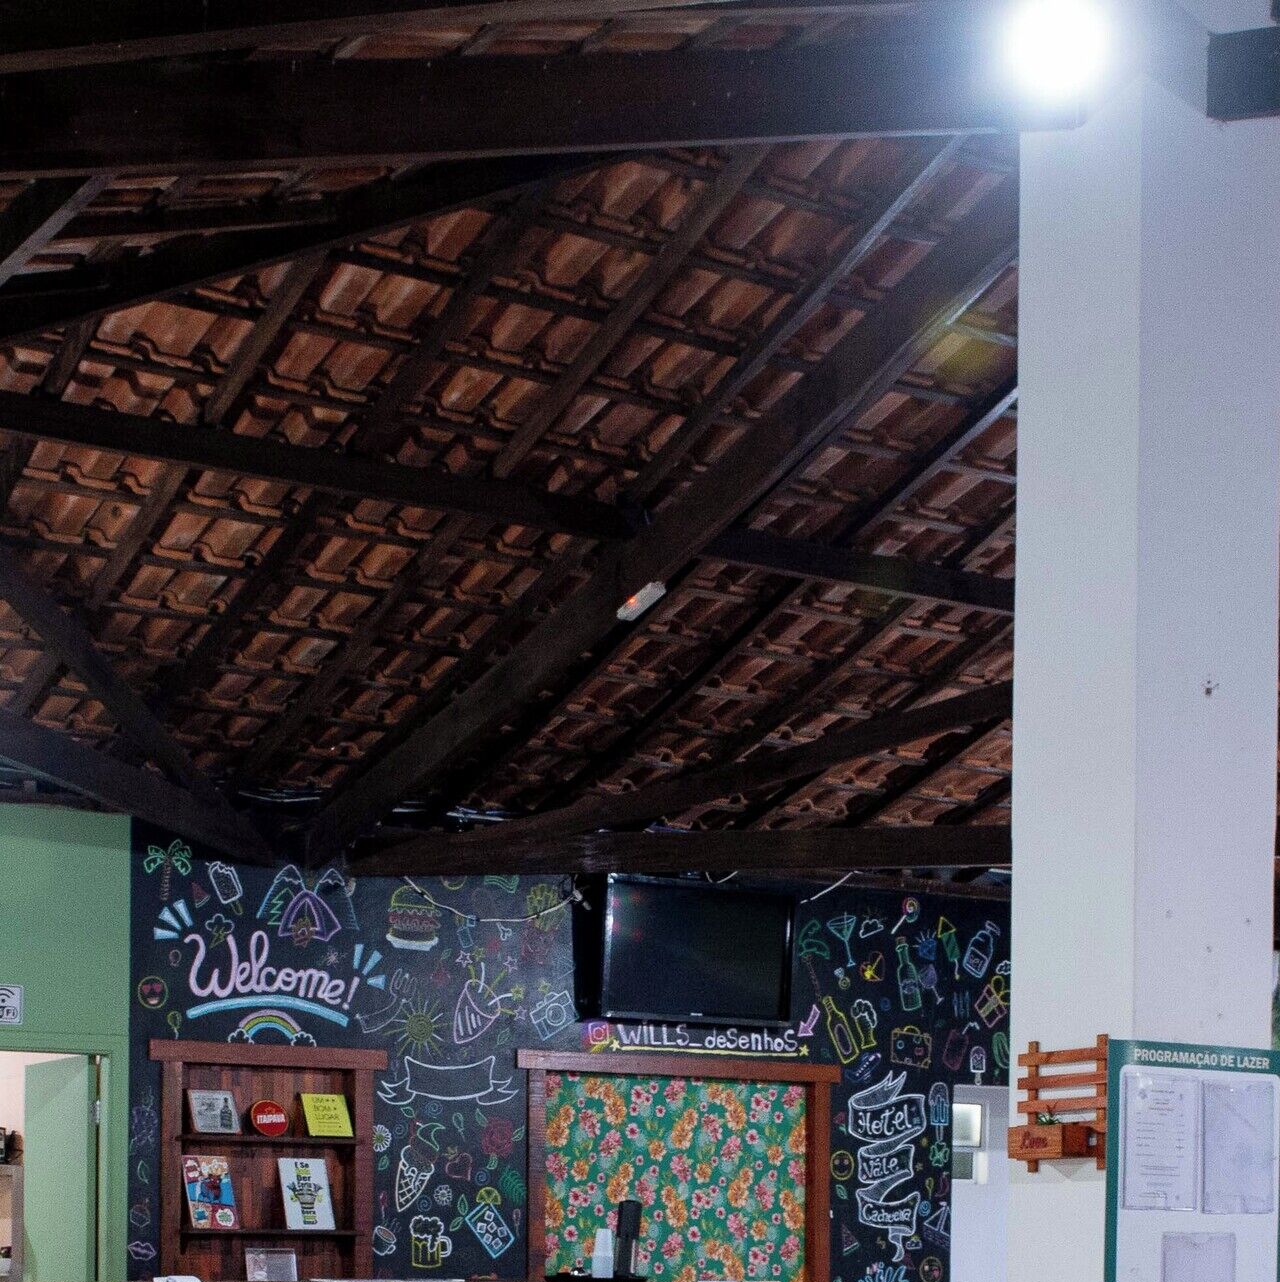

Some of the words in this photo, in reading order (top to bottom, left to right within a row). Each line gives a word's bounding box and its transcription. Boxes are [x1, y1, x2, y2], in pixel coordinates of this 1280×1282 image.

[184, 930, 361, 1010] Welcome!
[1134, 1048, 1218, 1067] PROGRAMAÇÃO
[1219, 1055, 1234, 1066] DE
[1237, 1057, 1270, 1069] LAZER
[858, 1104, 913, 1136] Hotel
